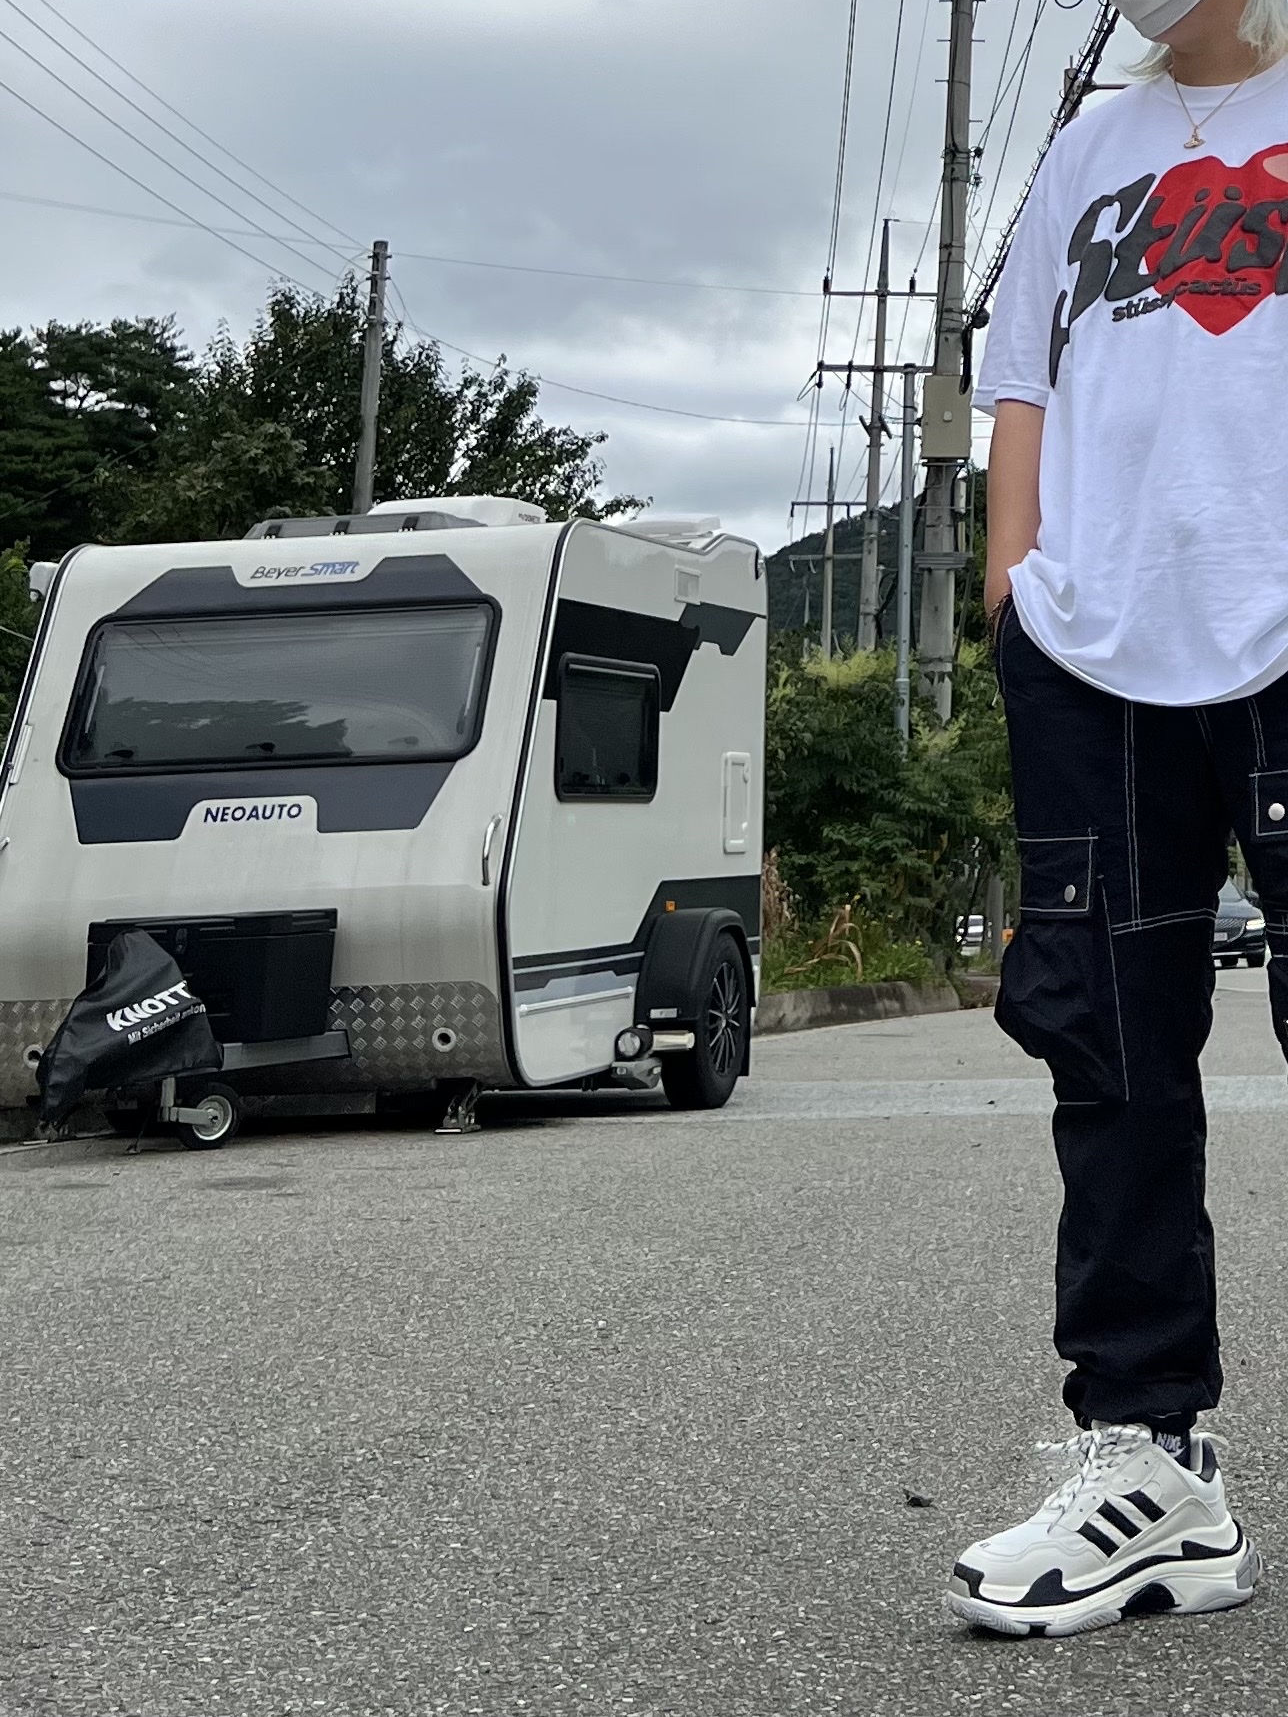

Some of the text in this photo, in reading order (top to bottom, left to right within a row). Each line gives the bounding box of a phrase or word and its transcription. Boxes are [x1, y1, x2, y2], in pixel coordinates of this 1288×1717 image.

[250, 560, 360, 580] Beyer Smart
[203, 803, 302, 823] NEOAUTO
[106, 980, 193, 1032] KNOTT
[1156, 1432, 1182, 1452] NIKE
